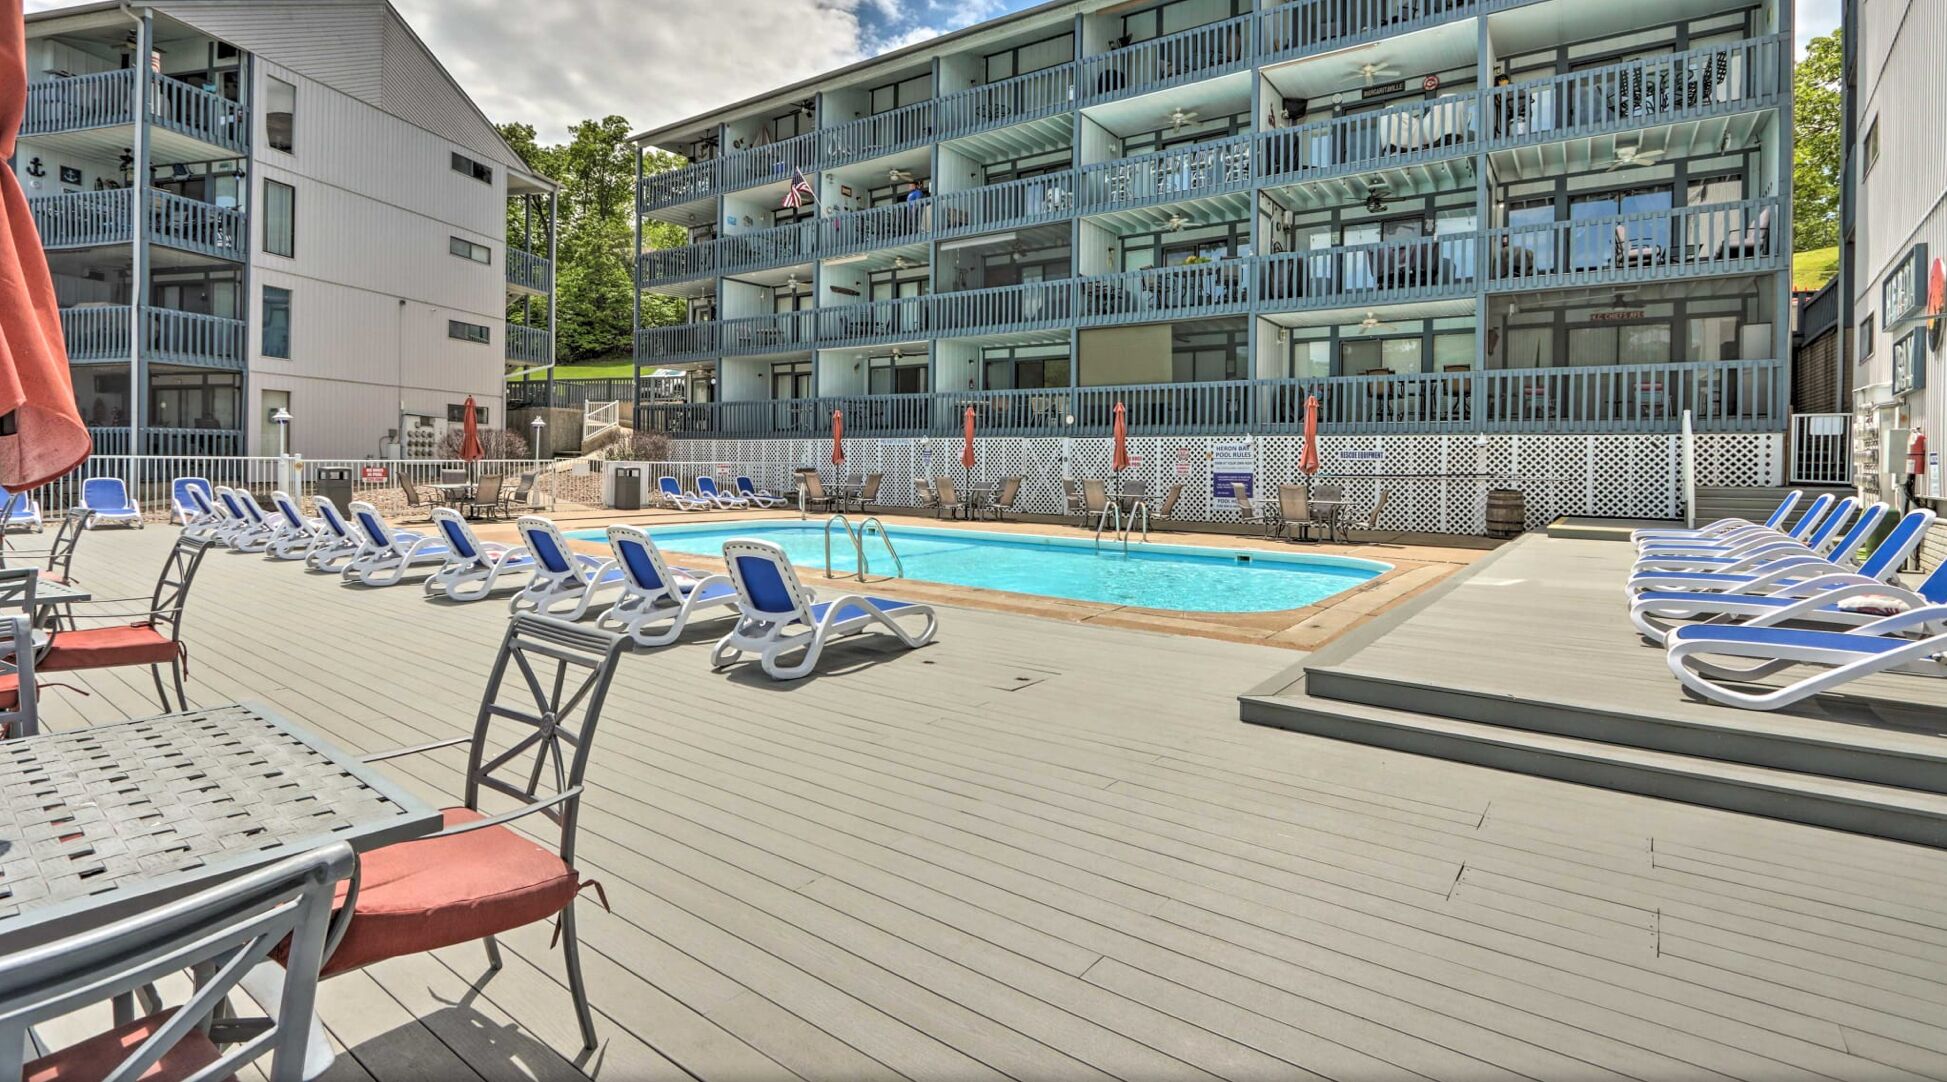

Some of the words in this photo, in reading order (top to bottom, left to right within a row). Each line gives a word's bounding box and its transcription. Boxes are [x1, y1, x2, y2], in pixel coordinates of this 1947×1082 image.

[1363, 82, 1403, 97] MARGARITAVILLE
[1340, 451, 1357, 459] RESCUE
[1357, 451, 1384, 459] EQUIPMENT
